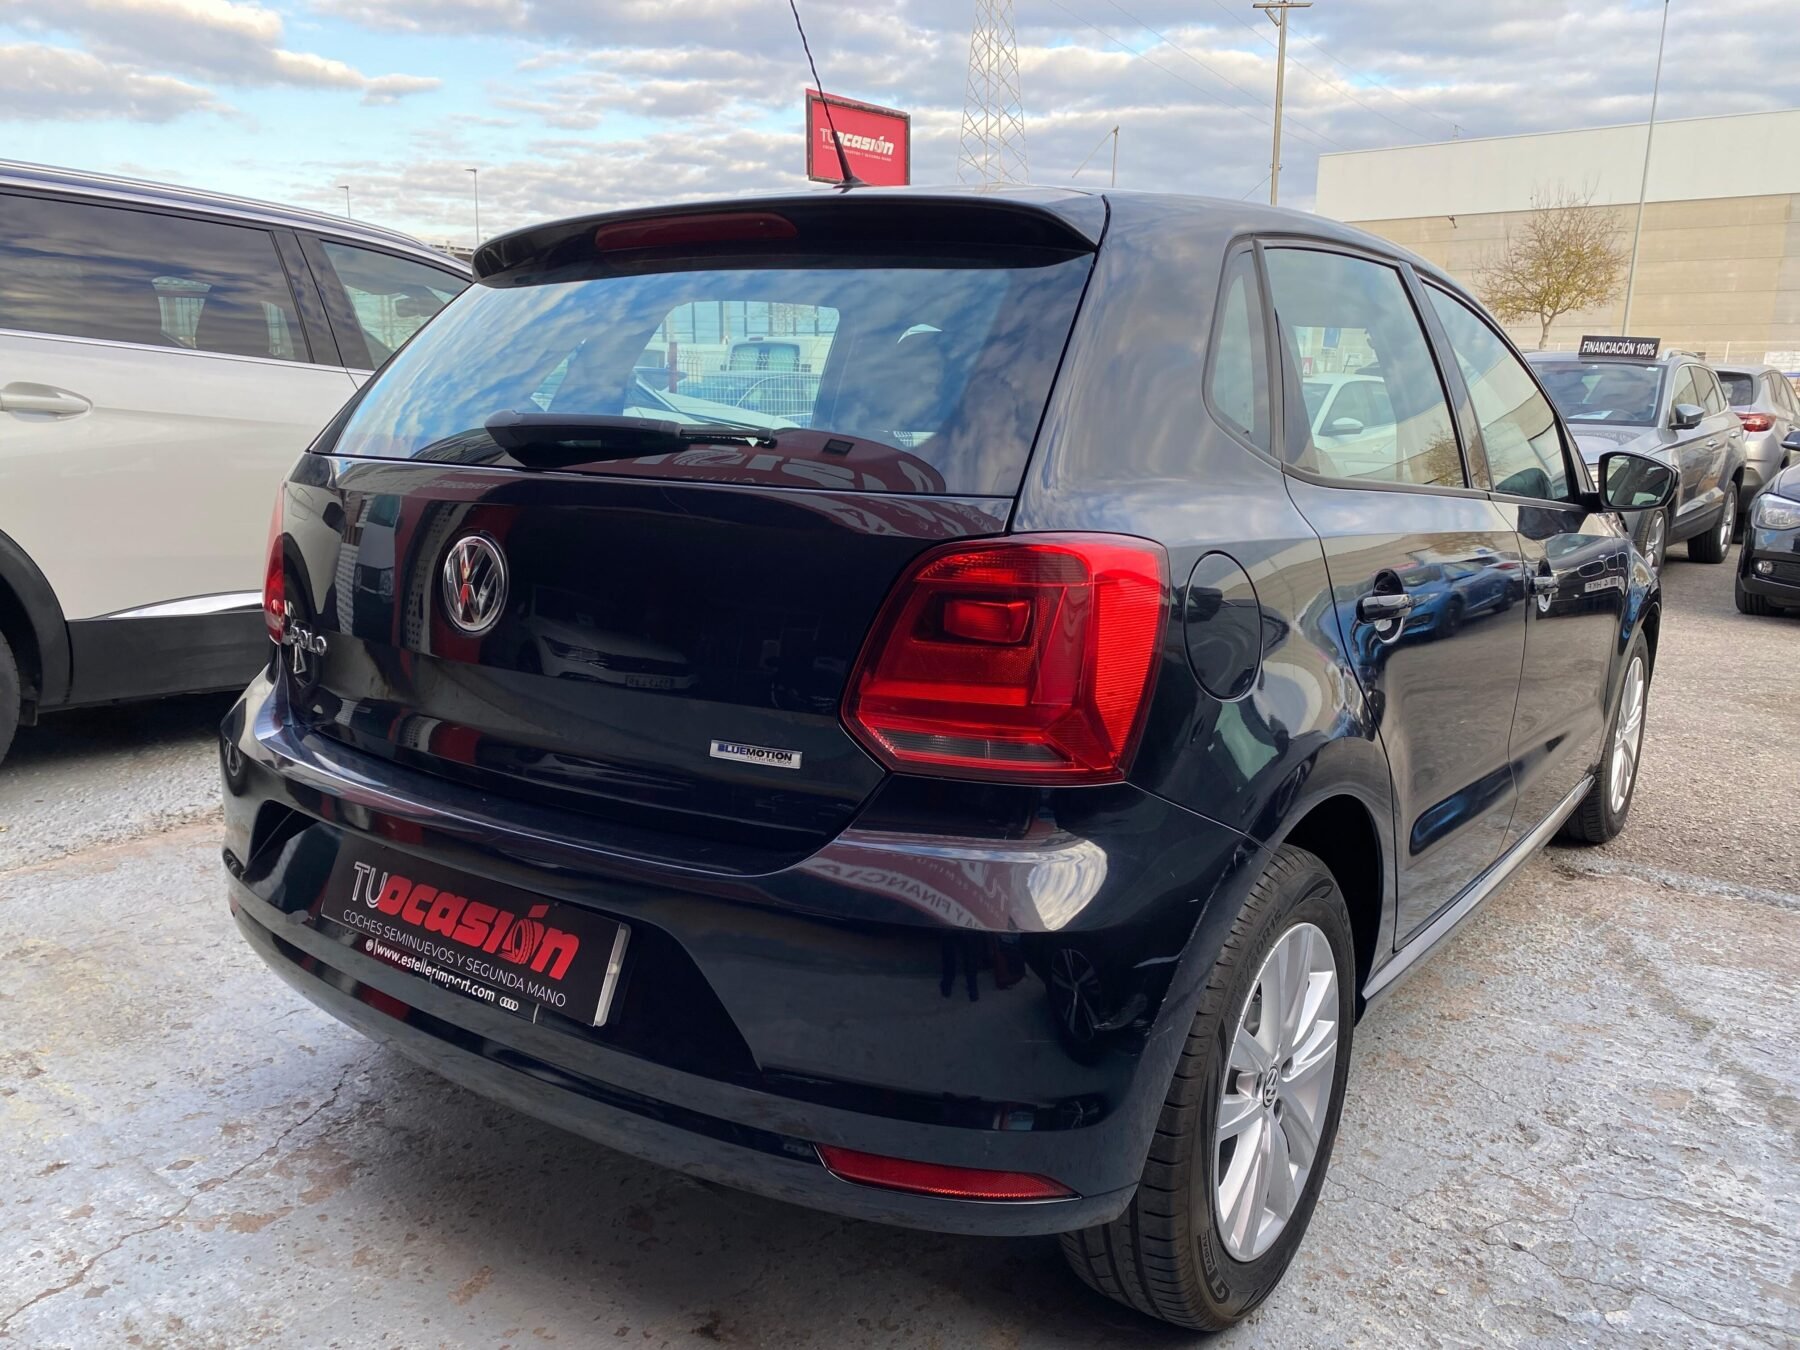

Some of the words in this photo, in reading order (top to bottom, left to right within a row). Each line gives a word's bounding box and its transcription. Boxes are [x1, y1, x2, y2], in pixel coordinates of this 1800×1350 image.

[1582, 339, 1635, 355] FINANCIACIÓN
[1636, 342, 1656, 356] 100%
[290, 625, 327, 656] POLO
[717, 743, 793, 761] BLUEMOTION
[343, 909, 383, 935] COCHES
[383, 924, 455, 964] SEMINUEVOS
[457, 953, 466, 967] Y
[465, 957, 524, 992] SEGUNDA
[527, 981, 566, 1007] MANO
